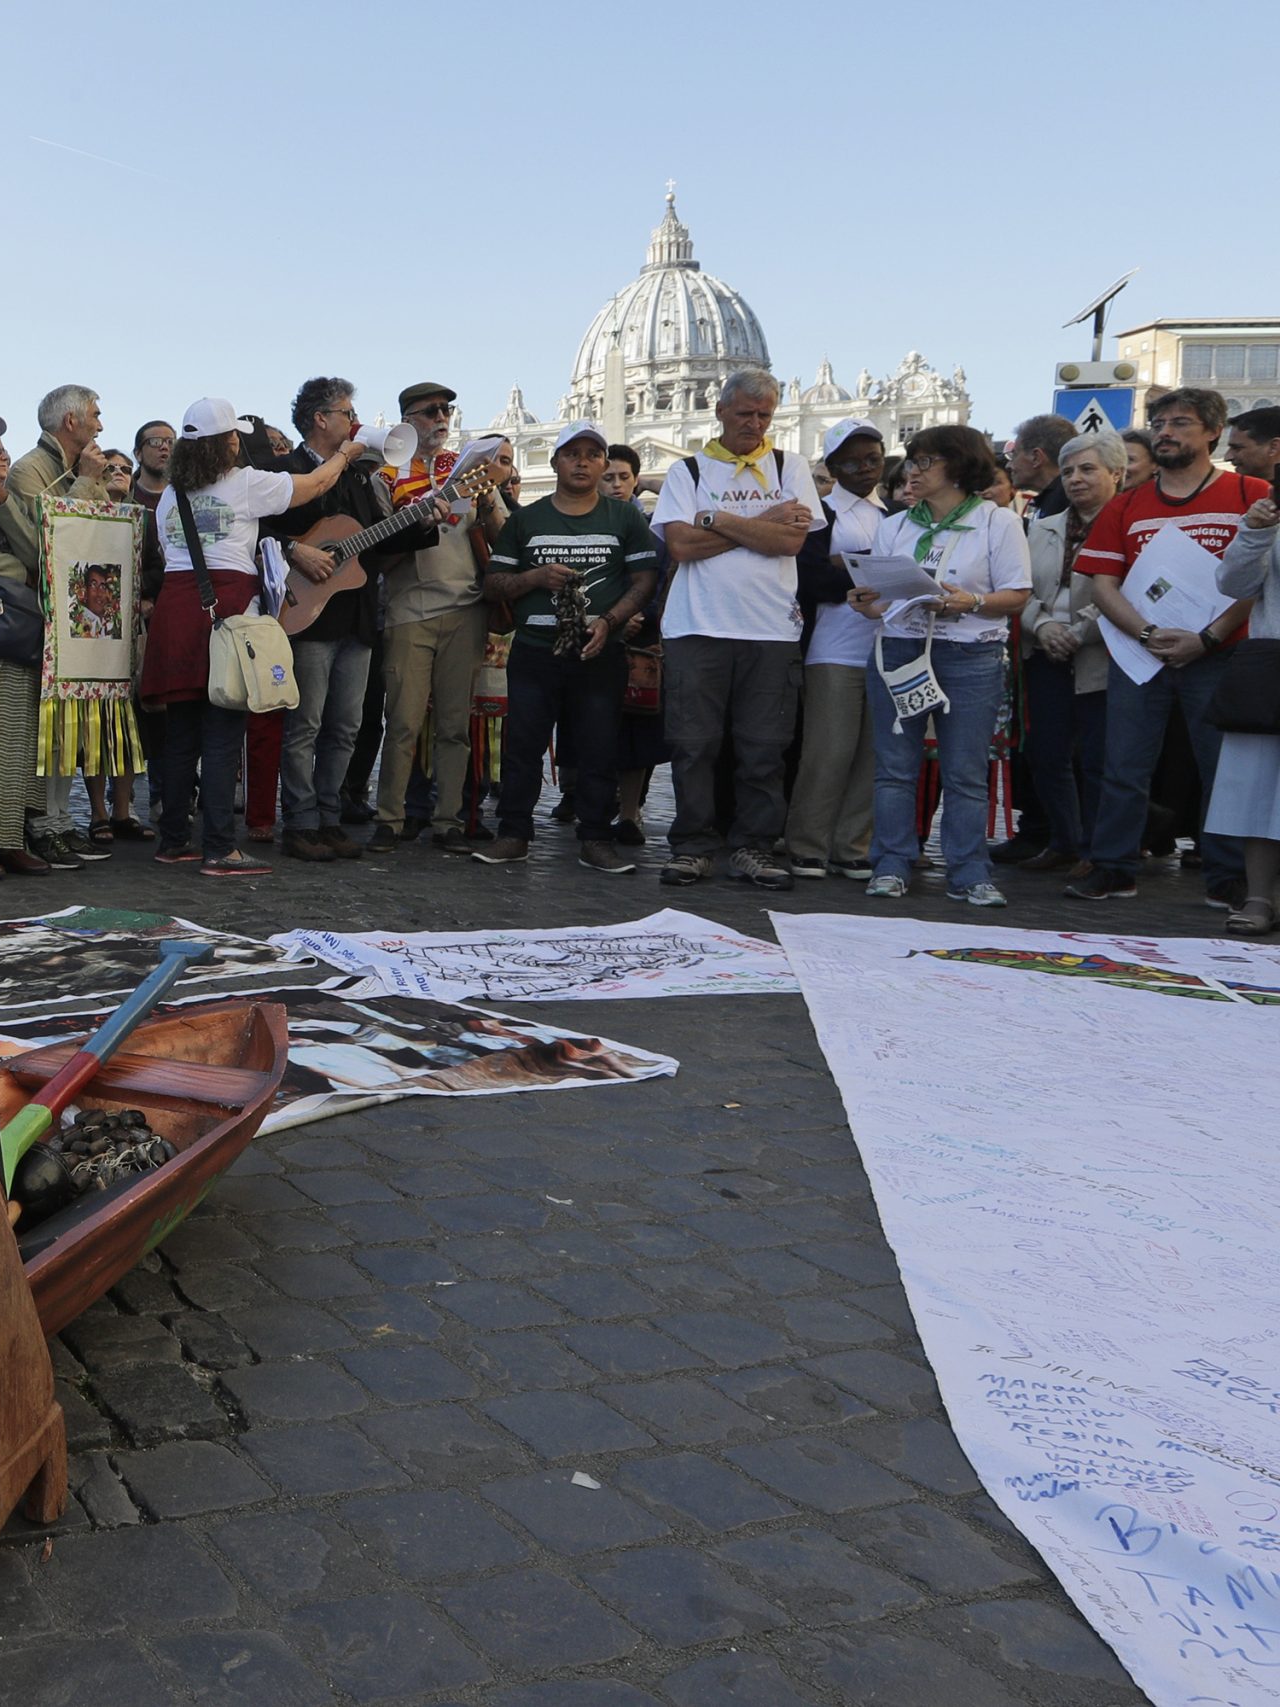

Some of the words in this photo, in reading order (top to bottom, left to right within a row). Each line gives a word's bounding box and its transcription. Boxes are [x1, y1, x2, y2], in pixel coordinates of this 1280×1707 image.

[1184, 527, 1230, 537] NDÍGENA
[571, 546, 612, 555] INDÍGENA
[588, 555, 607, 563] NÓS
